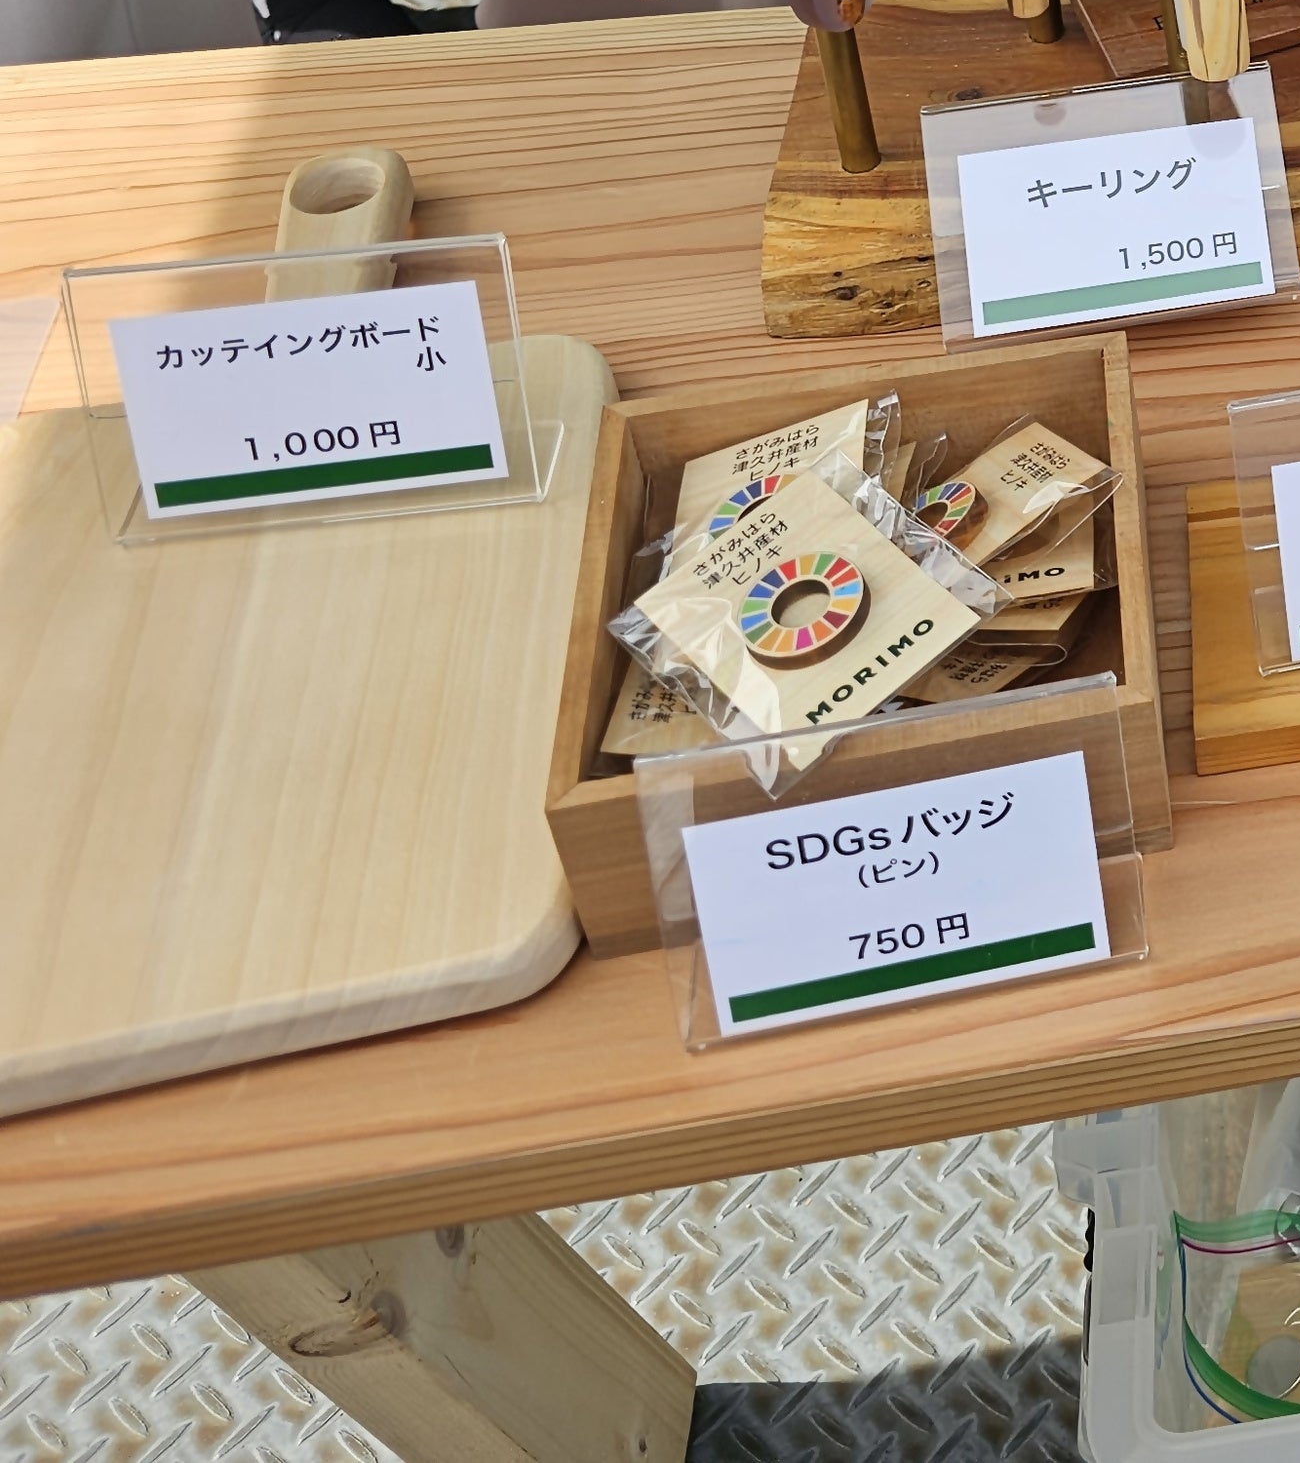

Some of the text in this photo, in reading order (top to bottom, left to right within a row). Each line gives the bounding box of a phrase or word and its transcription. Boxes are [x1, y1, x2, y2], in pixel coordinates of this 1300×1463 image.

[1026, 156, 1198, 208] キーリング
[416, 345, 447, 372] 小
[731, 435, 820, 476] 津久井産材
[735, 424, 820, 460] さがみはら
[749, 456, 801, 482] ヒノキ
[692, 511, 777, 578] さがみはら
[701, 519, 790, 590] 津久井産材
[732, 544, 784, 586] ヒノキ
[805, 618, 935, 725] MORIMO
[857, 850, 941, 889] (ピン)
